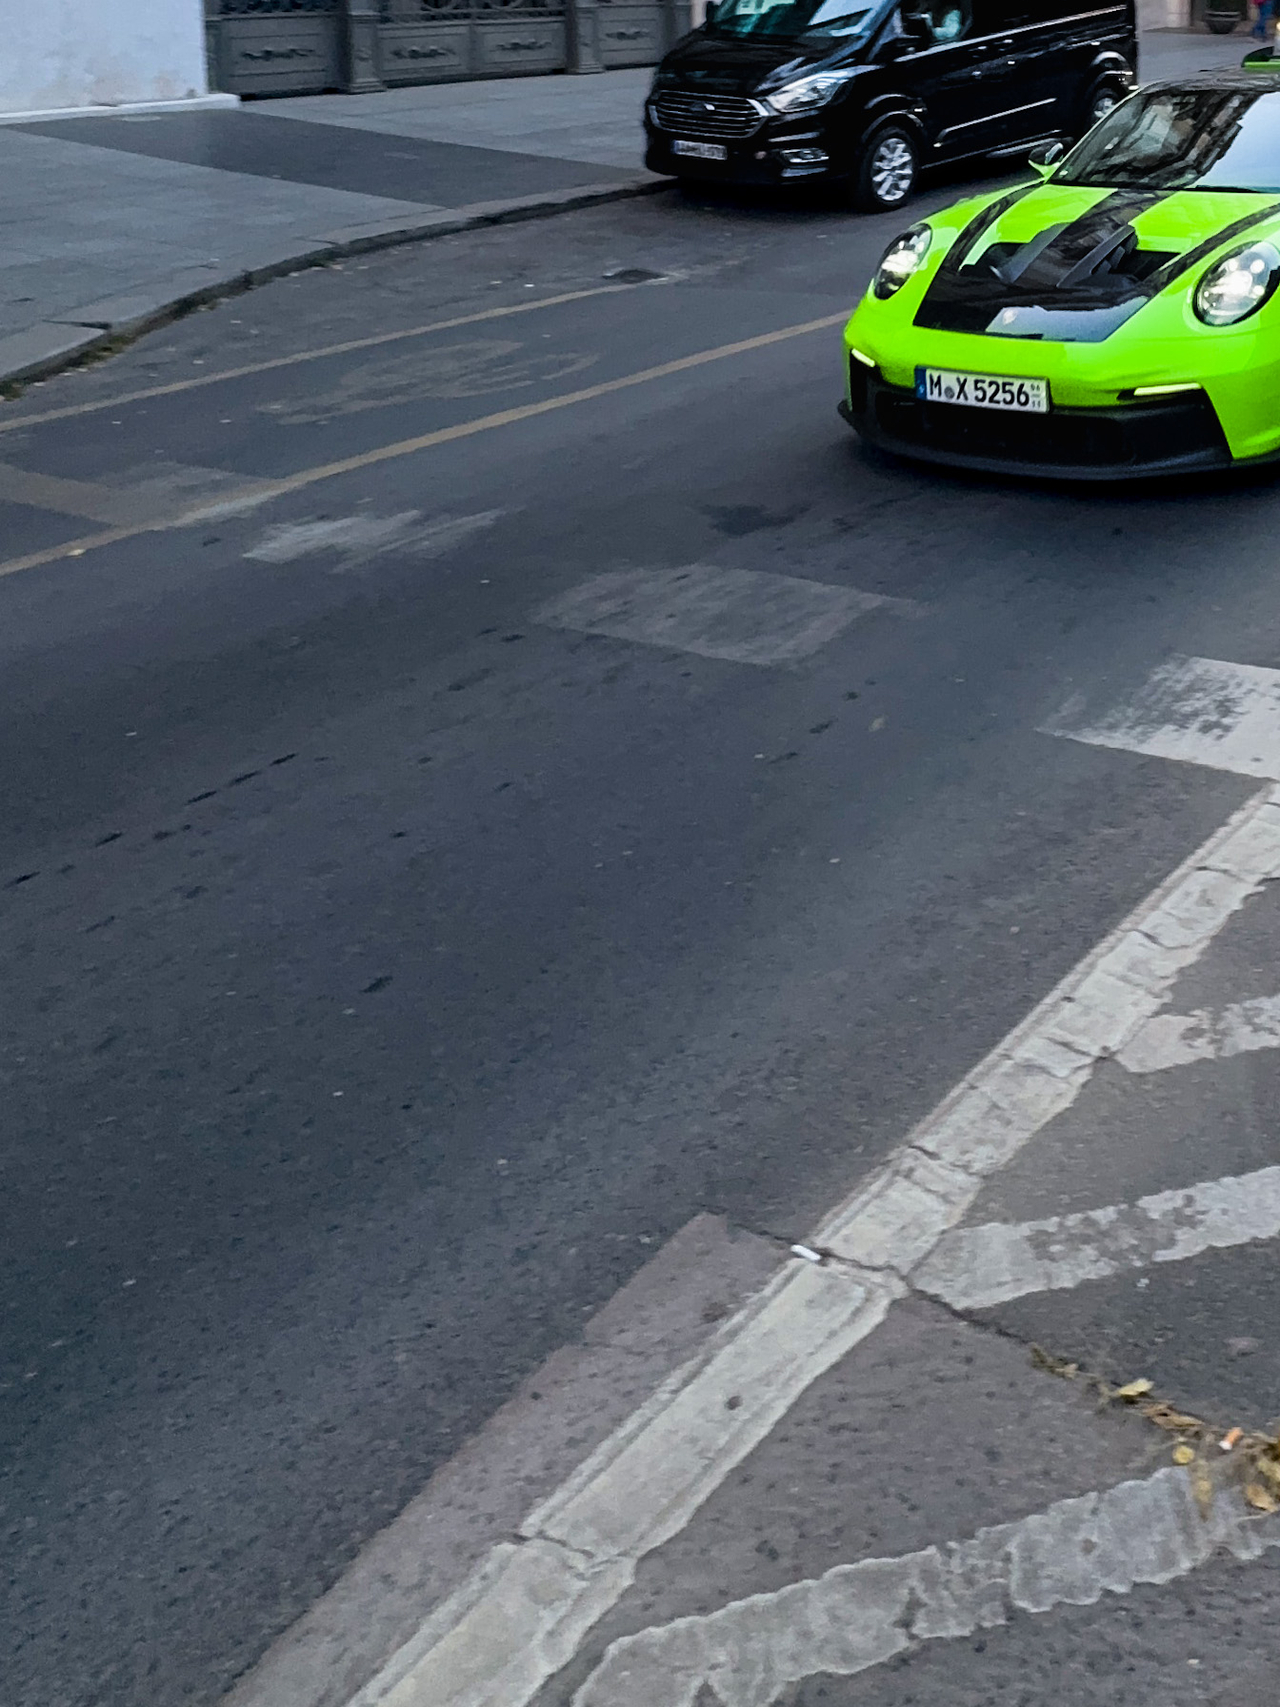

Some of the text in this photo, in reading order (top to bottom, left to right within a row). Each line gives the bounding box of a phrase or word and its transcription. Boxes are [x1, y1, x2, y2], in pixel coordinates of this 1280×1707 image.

[928, 373, 1030, 407] M X 5256
